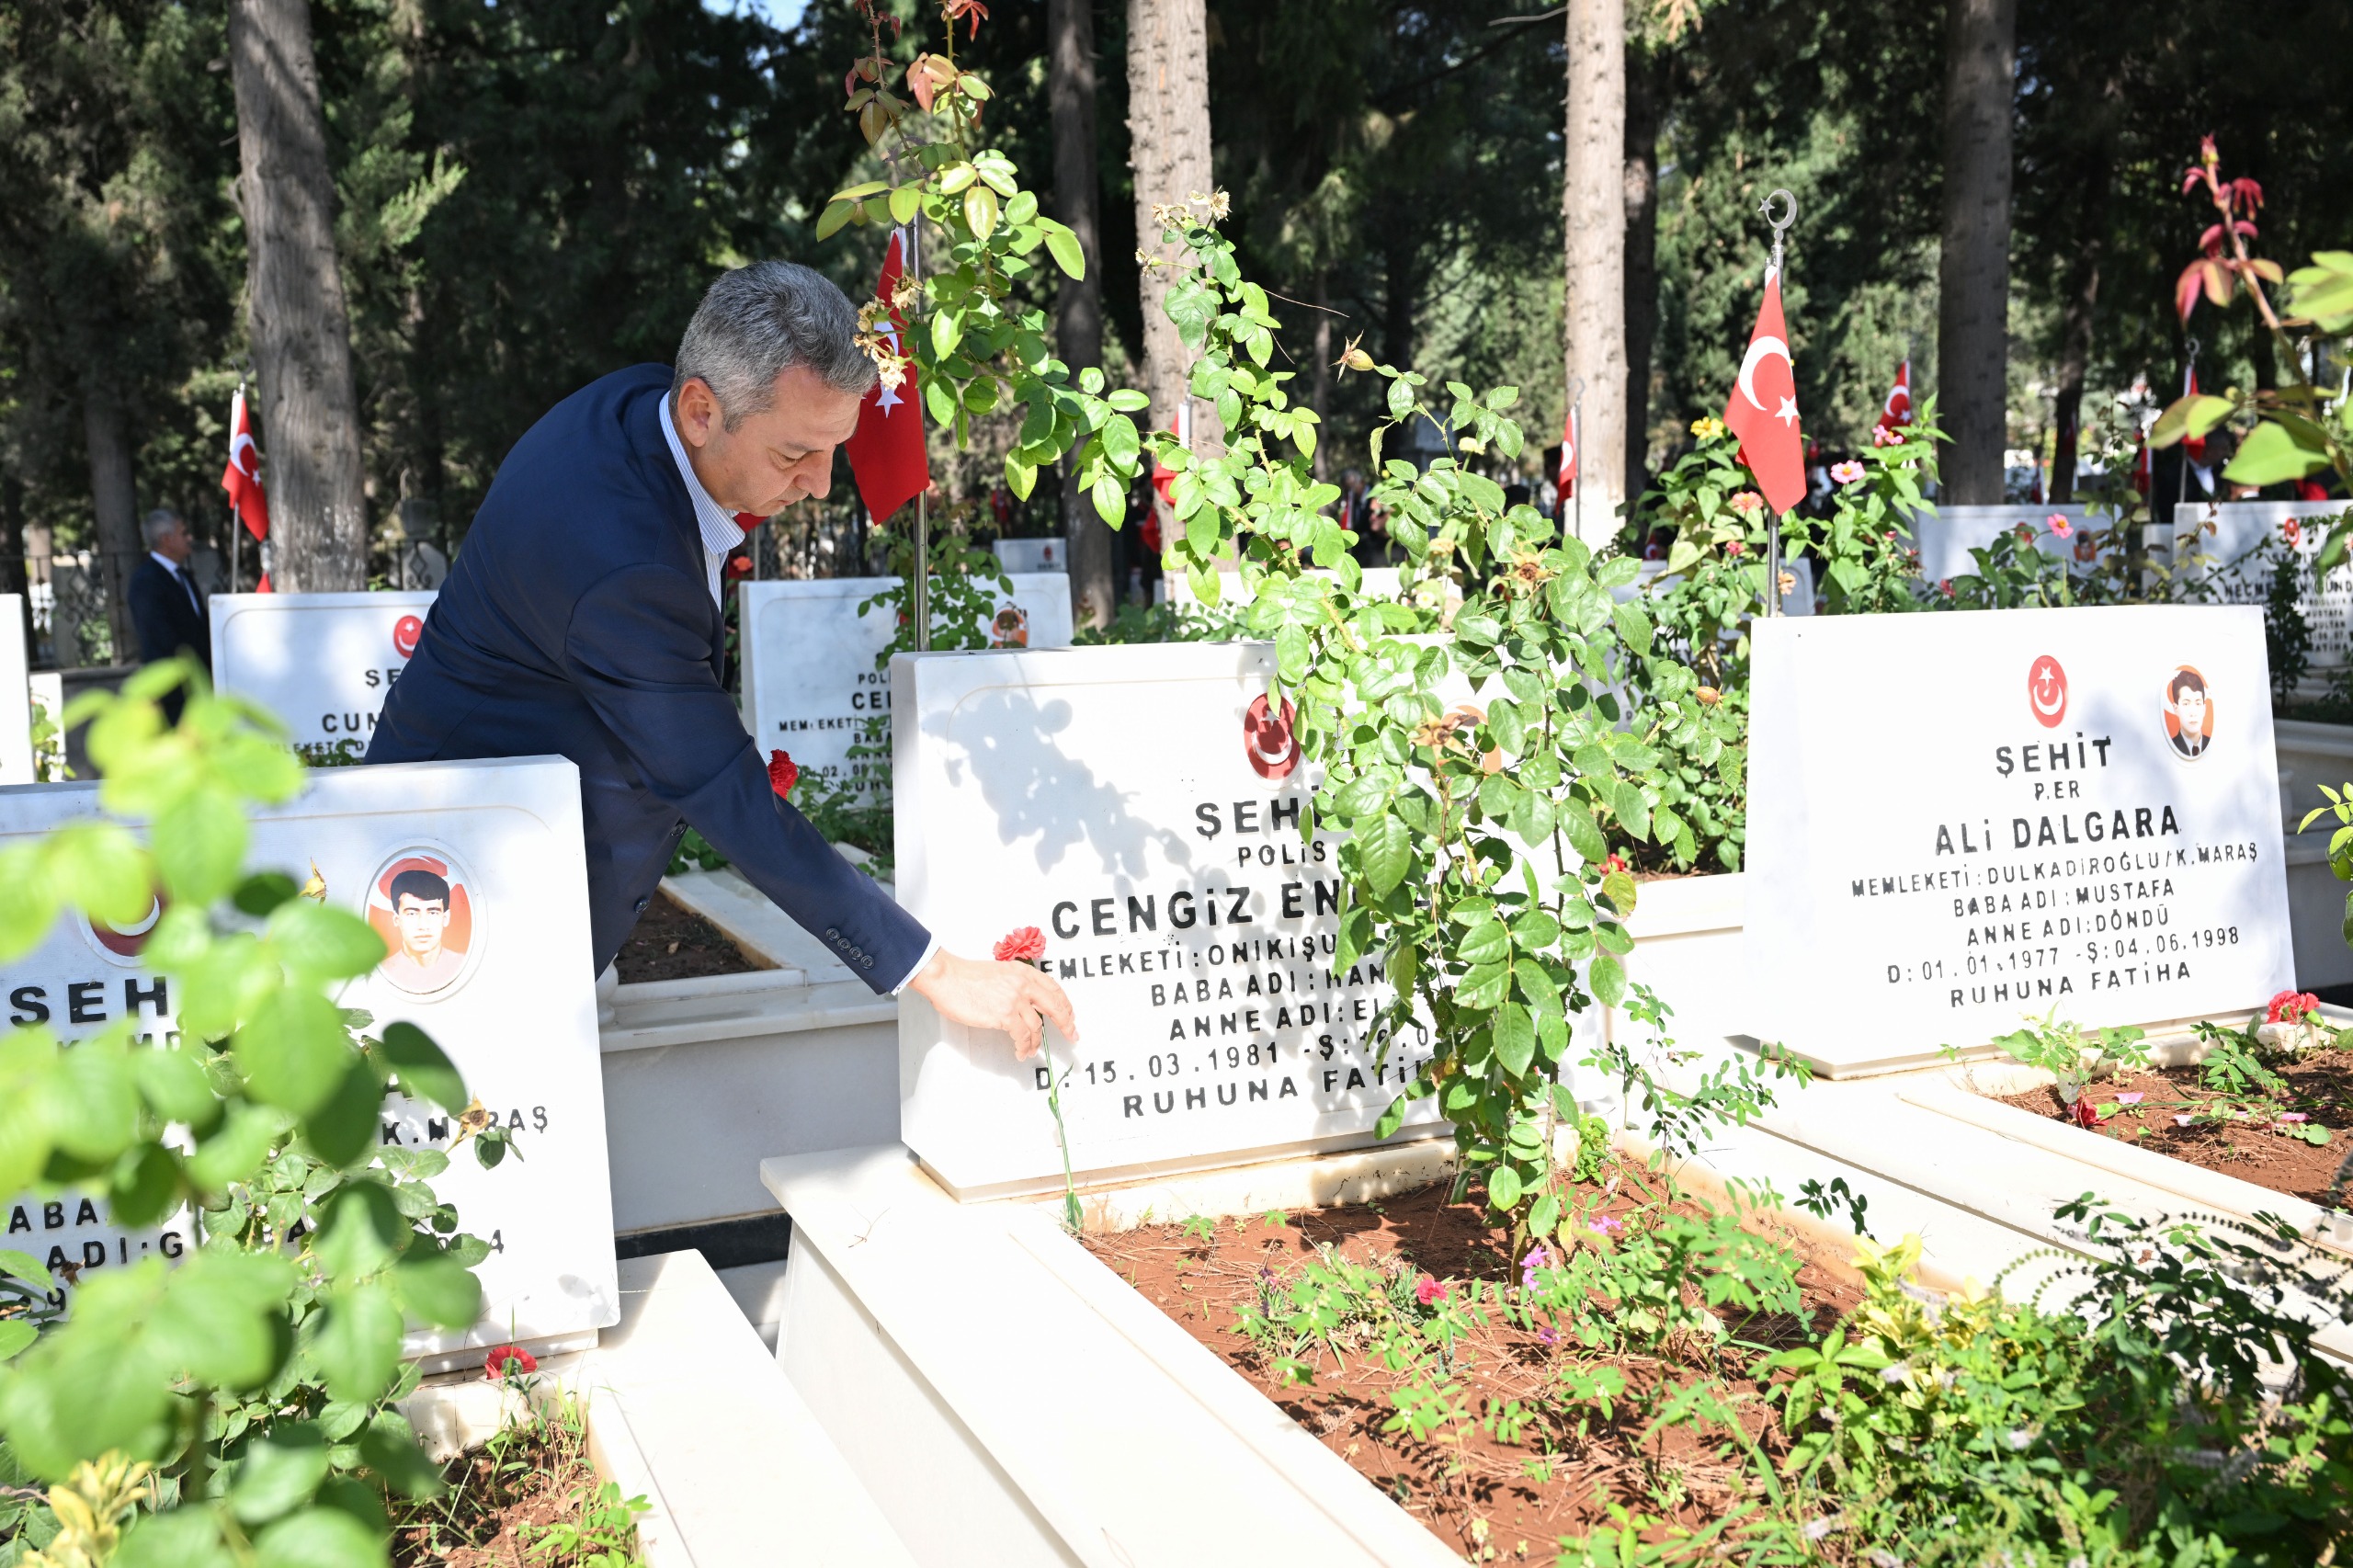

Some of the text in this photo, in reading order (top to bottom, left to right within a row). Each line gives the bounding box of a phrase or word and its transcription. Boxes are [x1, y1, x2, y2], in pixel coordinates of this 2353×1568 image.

[858, 672, 892, 685] POL
[2013, 804, 2179, 849] DALGARA
[1953, 890, 2013, 917] BABA
[1967, 922, 2032, 947] ANNE
[1151, 977, 1233, 1007] BABA
[1950, 976, 2075, 1008] RUHUNA
[1169, 1009, 1261, 1041] ANNE
[1122, 1075, 1299, 1119] RUHUNA
[8, 1198, 99, 1234] ABA
